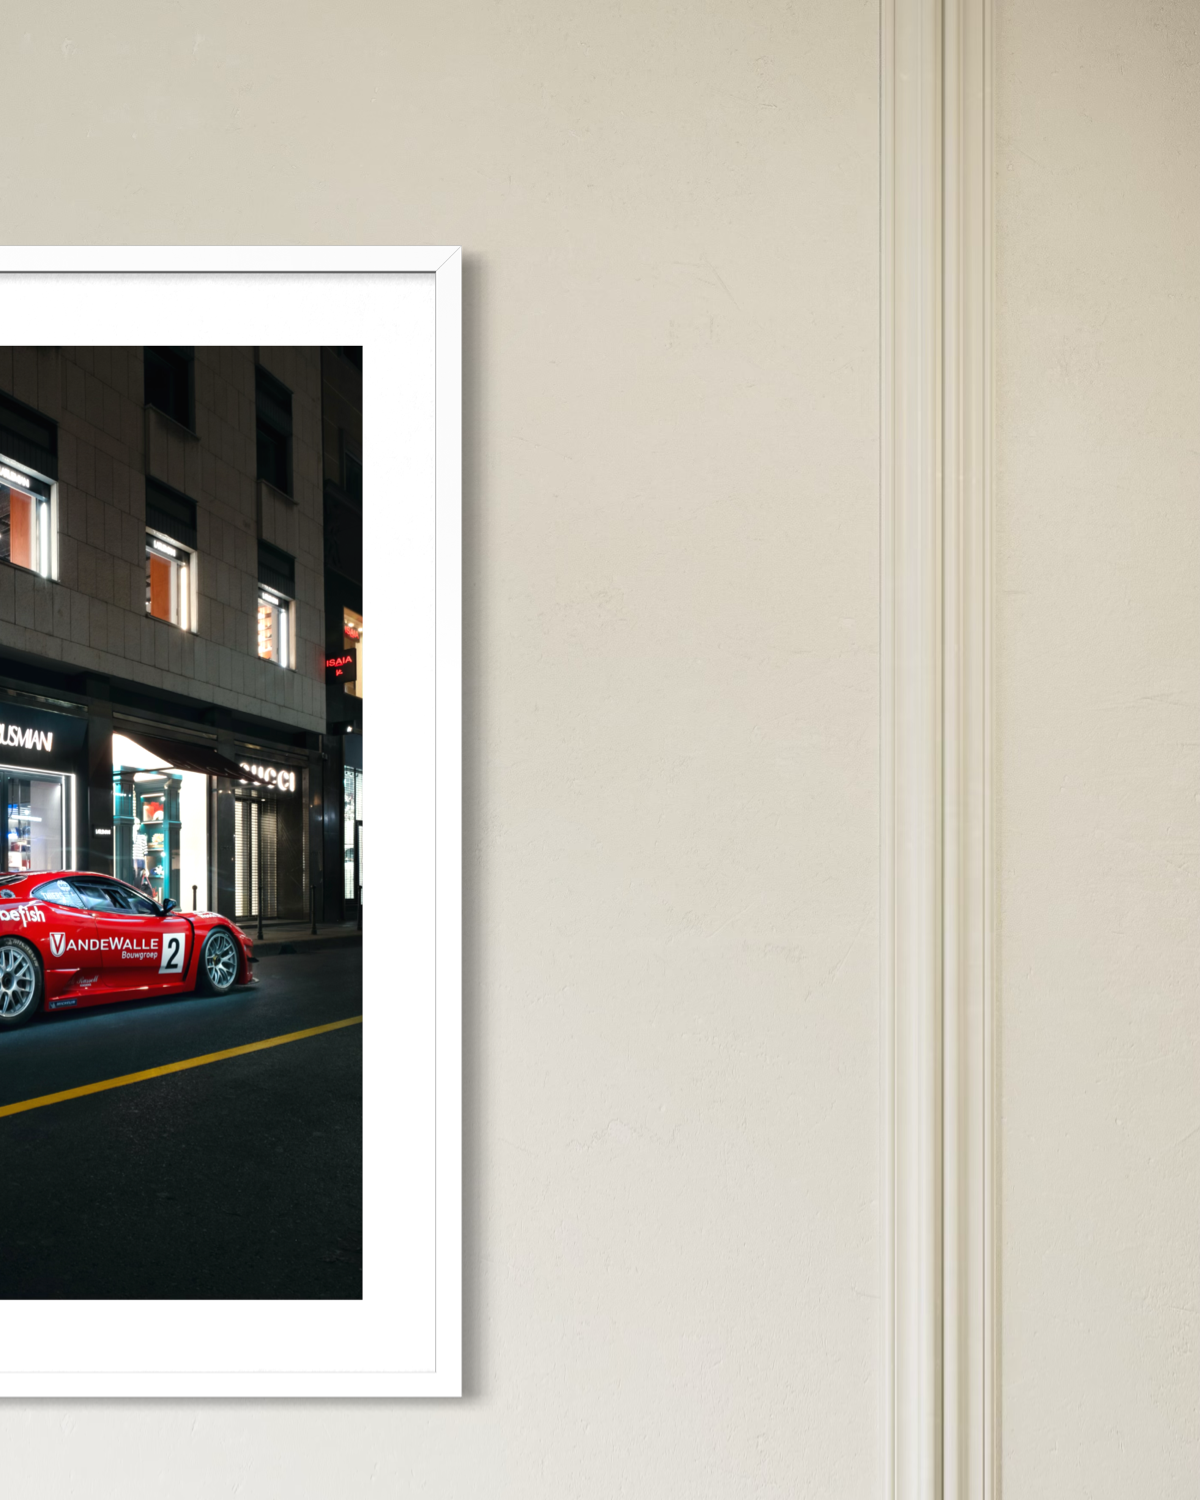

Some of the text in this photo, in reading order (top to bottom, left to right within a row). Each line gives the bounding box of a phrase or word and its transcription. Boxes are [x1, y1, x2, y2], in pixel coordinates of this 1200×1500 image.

[326, 656, 352, 667] ISAIA
[121, 951, 158, 960] Bouwgroep
[165, 937, 180, 970] 2
